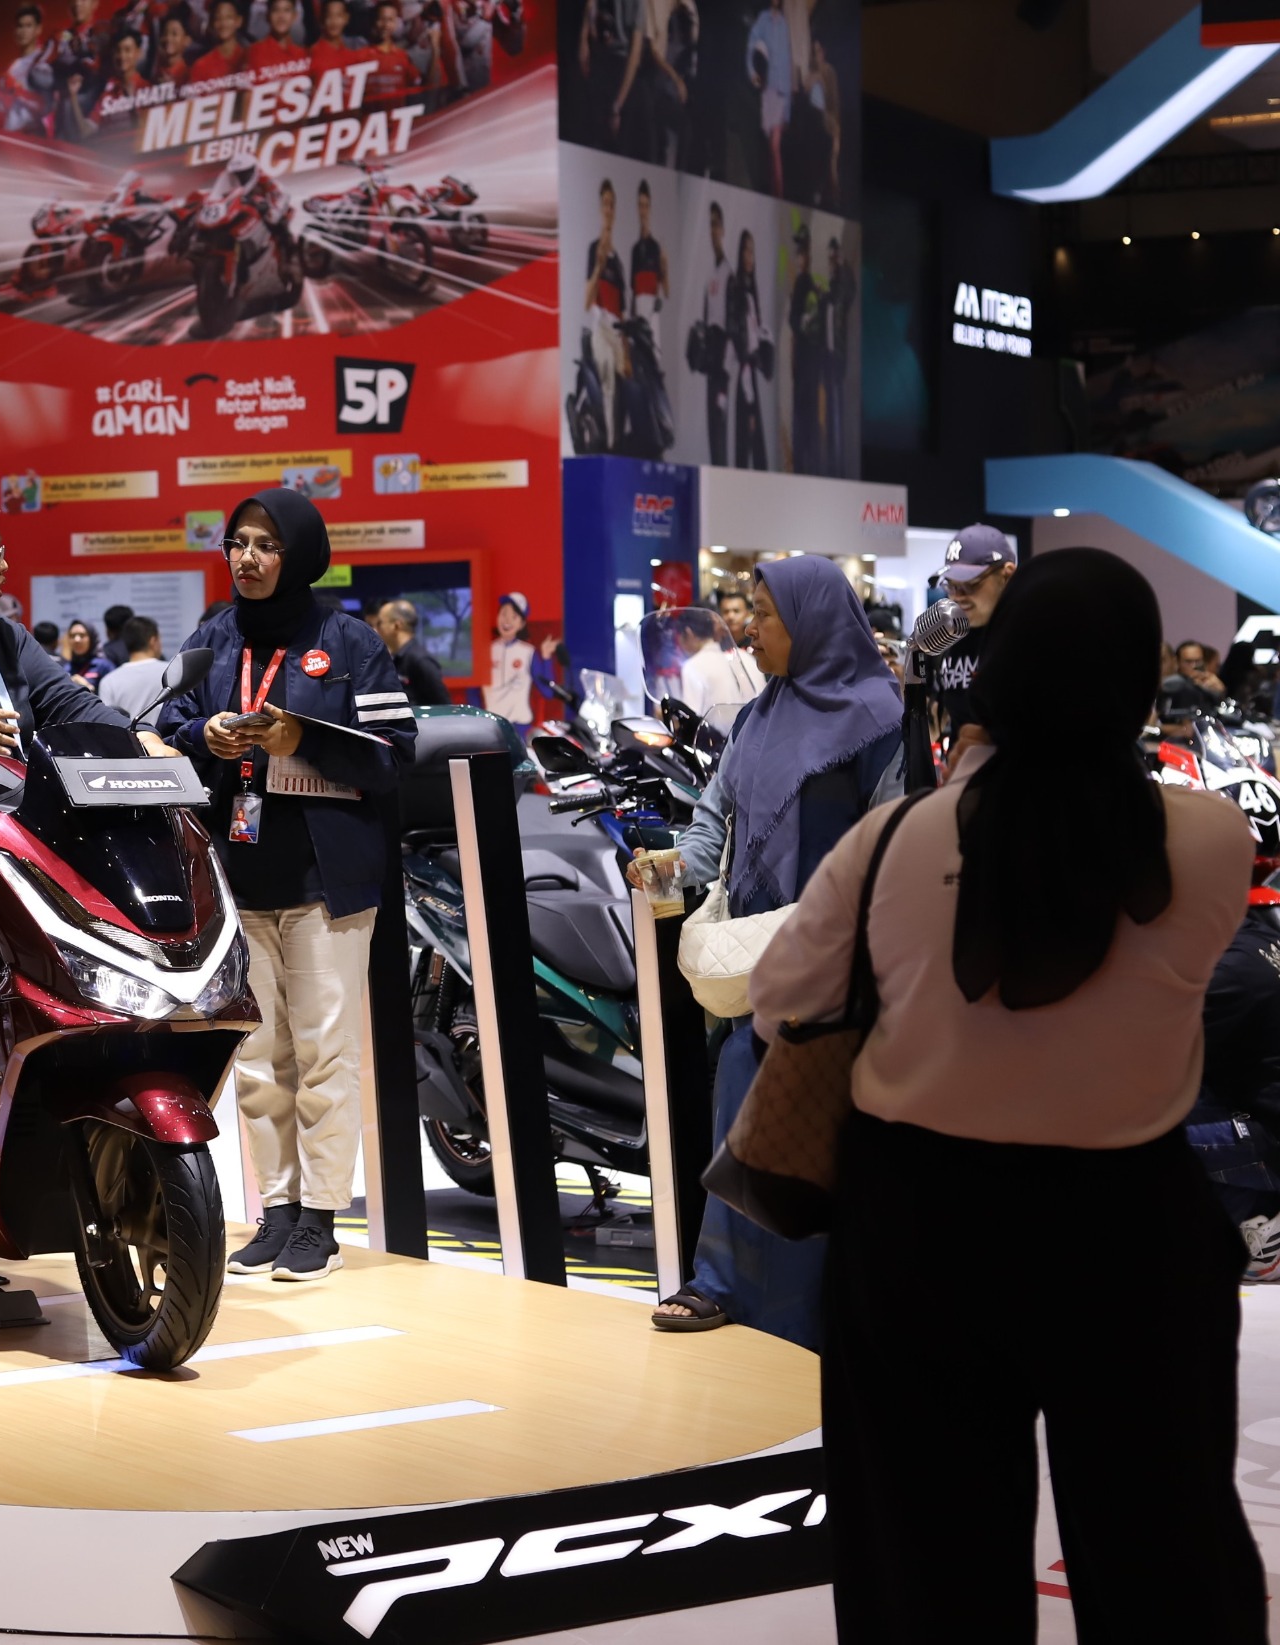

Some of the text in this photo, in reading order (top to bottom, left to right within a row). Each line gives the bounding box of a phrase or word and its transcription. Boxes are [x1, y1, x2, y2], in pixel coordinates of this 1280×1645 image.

[142, 60, 379, 152] MELESAT
[190, 104, 426, 177] LEBIH CEPAT
[225, 378, 262, 397] Saat
[264, 375, 296, 394] Naik
[338, 367, 409, 425] 5P
[216, 396, 258, 415] Motor
[260, 394, 306, 412] Honda
[234, 415, 288, 434] dengan
[861, 502, 905, 525] AHM
[304, 660, 329, 673] HEART.
[107, 779, 179, 789] HONDA
[1238, 781, 1277, 814] 46
[141, 894, 183, 903] HONDA
[316, 1531, 375, 1563] NEW
